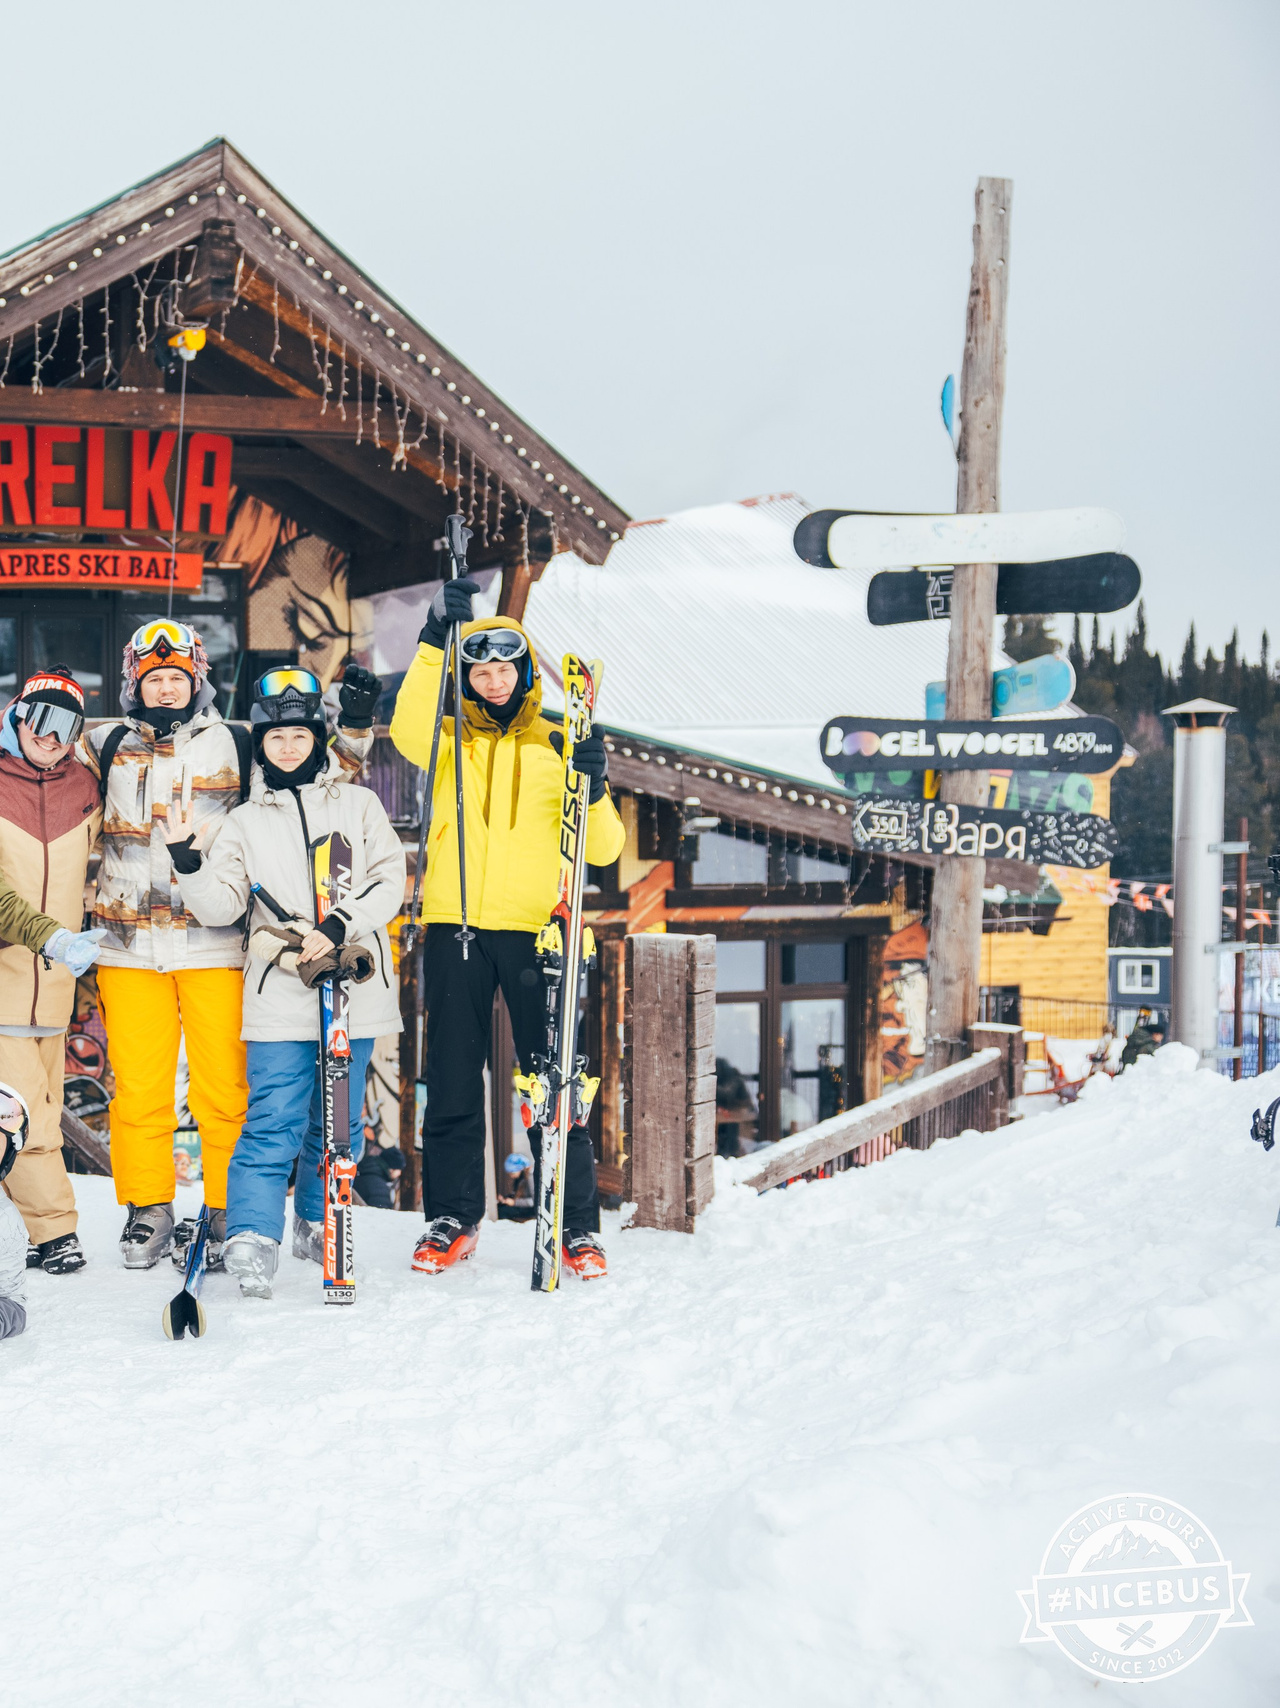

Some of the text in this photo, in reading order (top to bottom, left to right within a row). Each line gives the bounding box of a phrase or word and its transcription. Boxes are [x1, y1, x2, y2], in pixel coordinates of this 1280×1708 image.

[77, 554, 121, 579] SKI
[128, 555, 180, 581] BAR
[327, 1290, 353, 1298] L130
